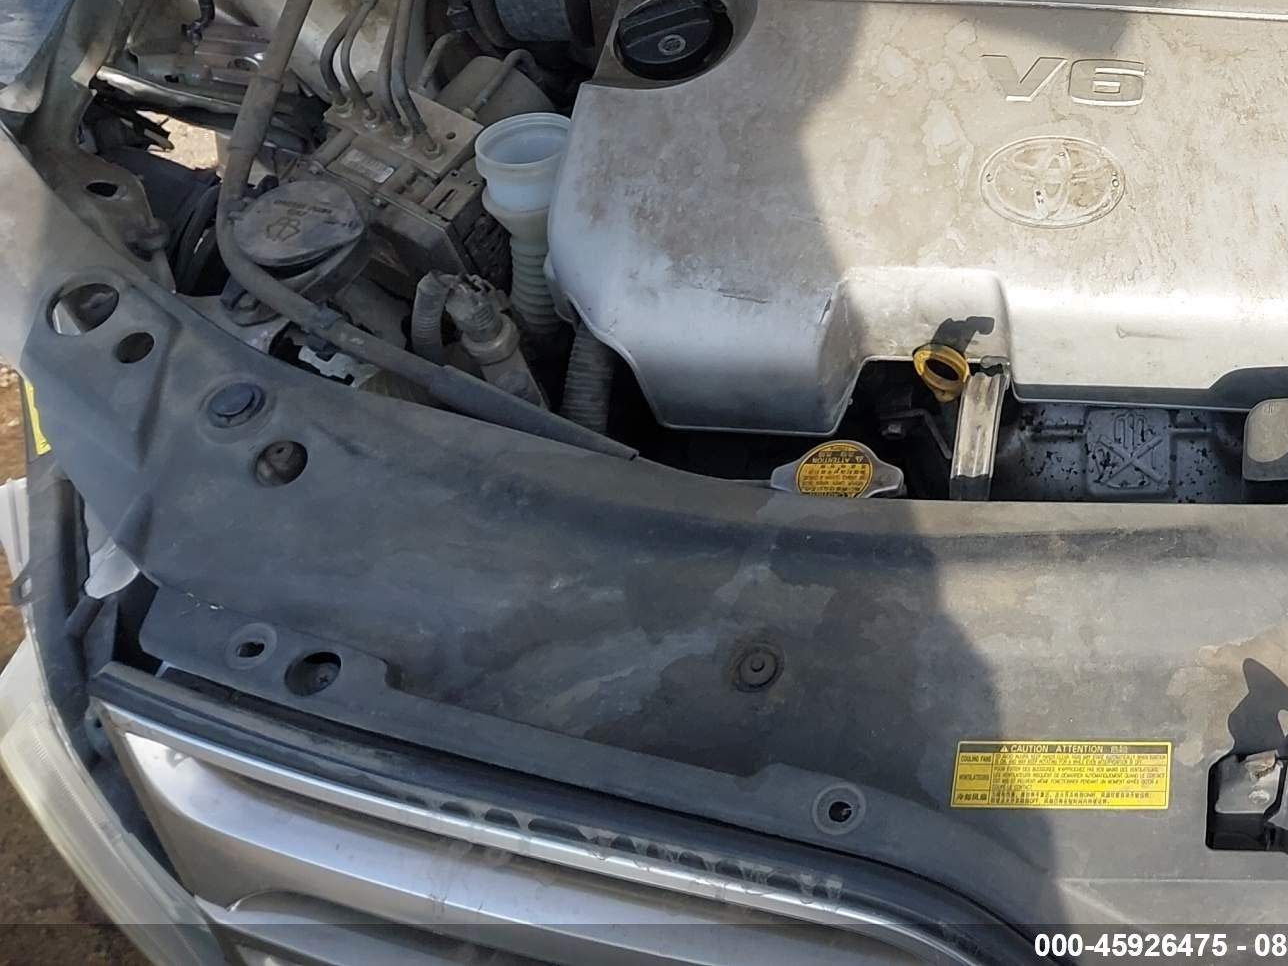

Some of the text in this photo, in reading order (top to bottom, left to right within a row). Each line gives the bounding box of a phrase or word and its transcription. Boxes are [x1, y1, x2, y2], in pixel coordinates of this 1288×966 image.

[981, 54, 1145, 107] V6
[1010, 745, 1049, 753] CAUTION
[1055, 745, 1104, 754] ATTENTION
